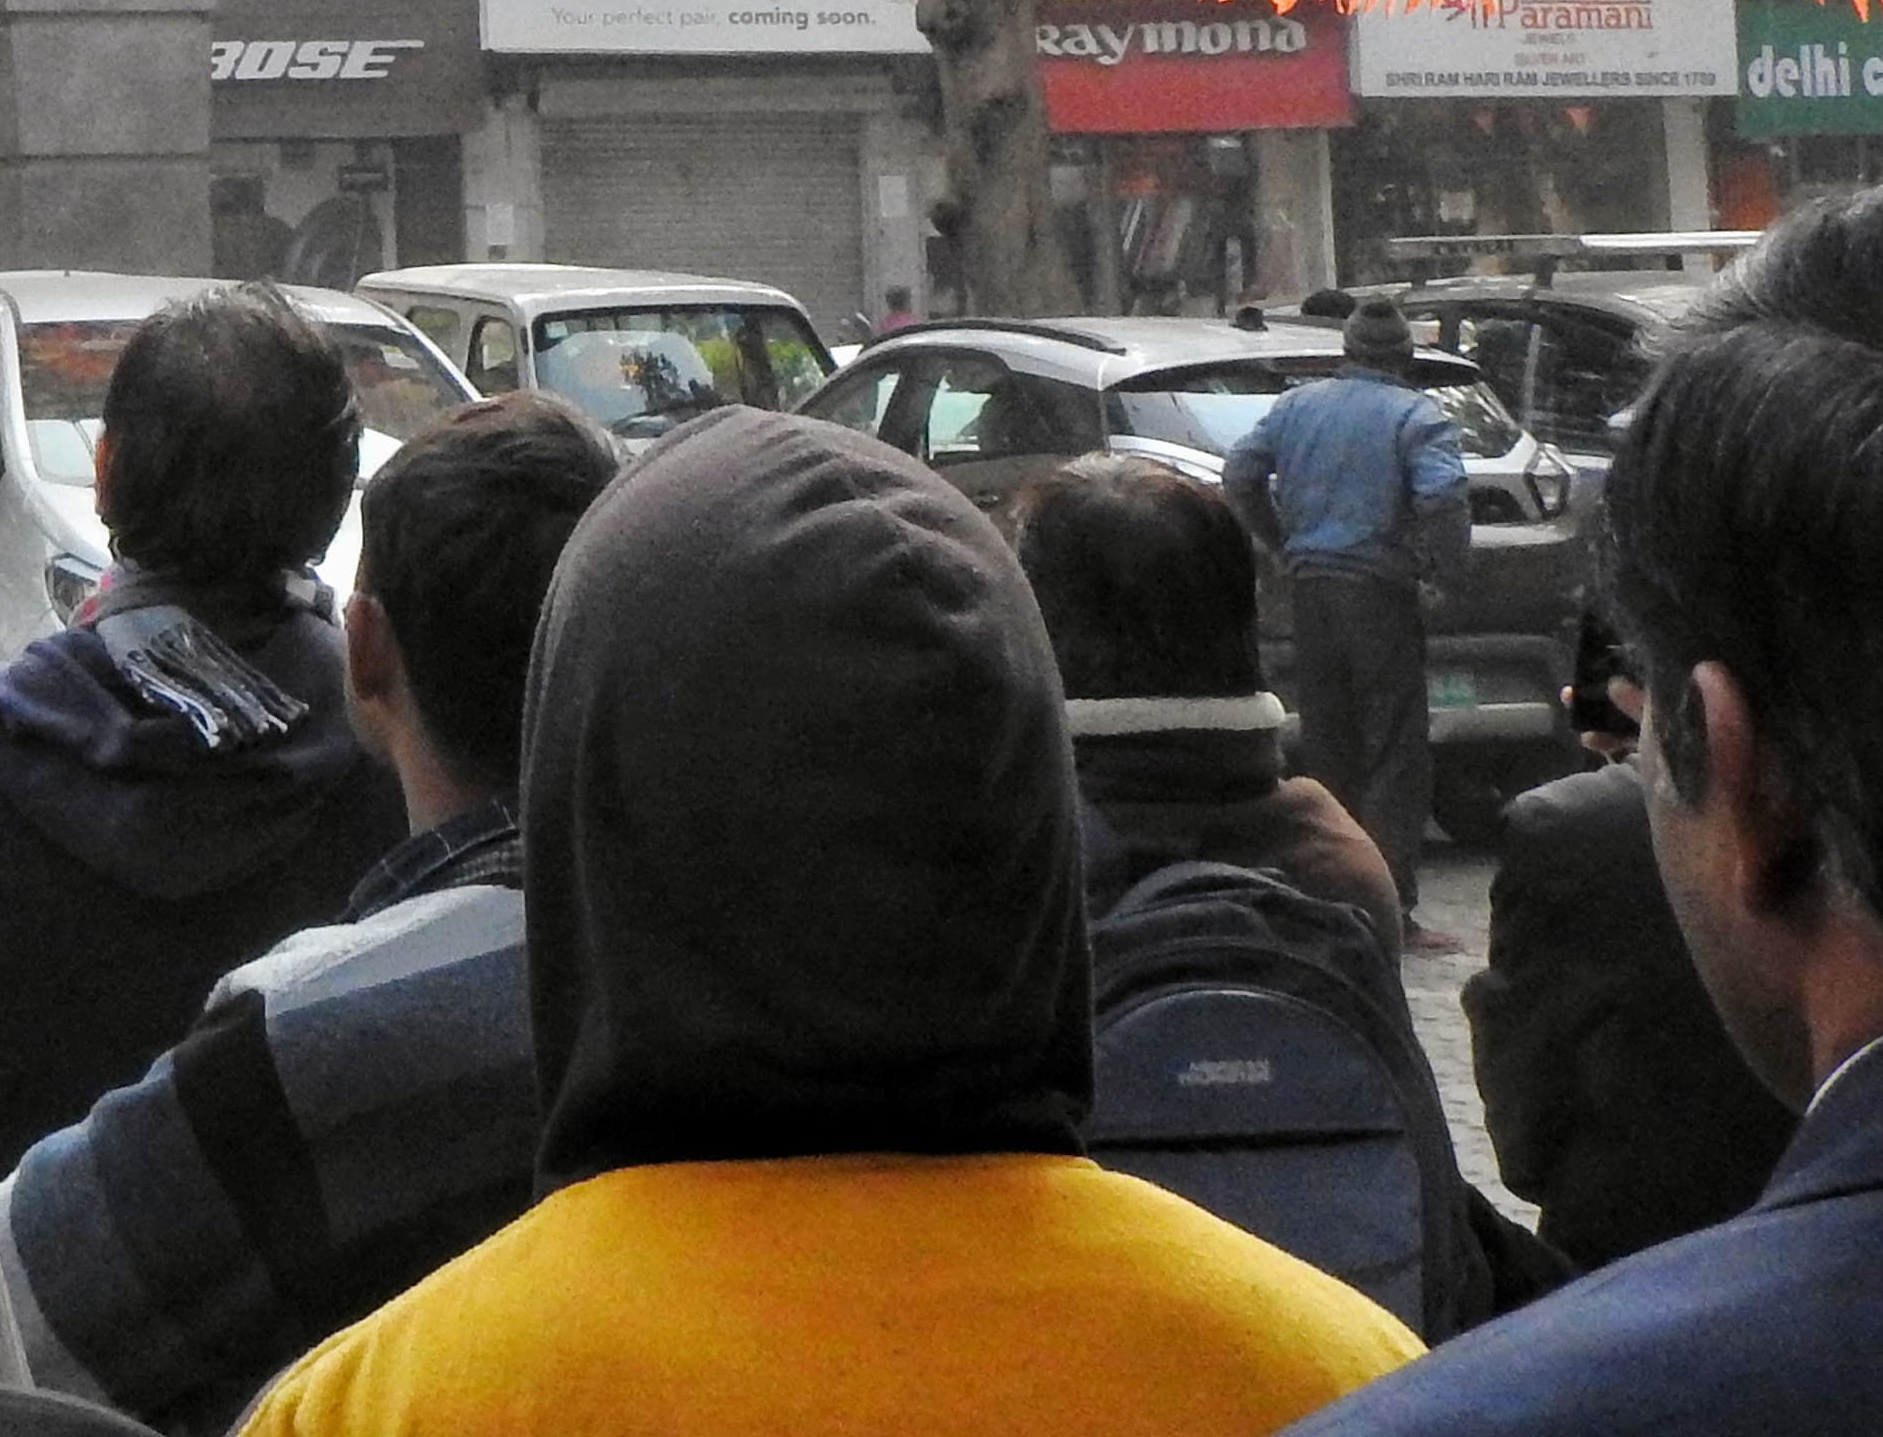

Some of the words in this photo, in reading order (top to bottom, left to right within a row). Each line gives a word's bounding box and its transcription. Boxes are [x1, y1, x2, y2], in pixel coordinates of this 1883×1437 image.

[551, 7, 593, 25] Your
[603, 6, 674, 27] perfect
[728, 7, 808, 30] coming
[817, 11, 877, 25] soon.
[1542, 72, 1631, 87] JEWELLERS
[1747, 41, 1851, 98] delhi
